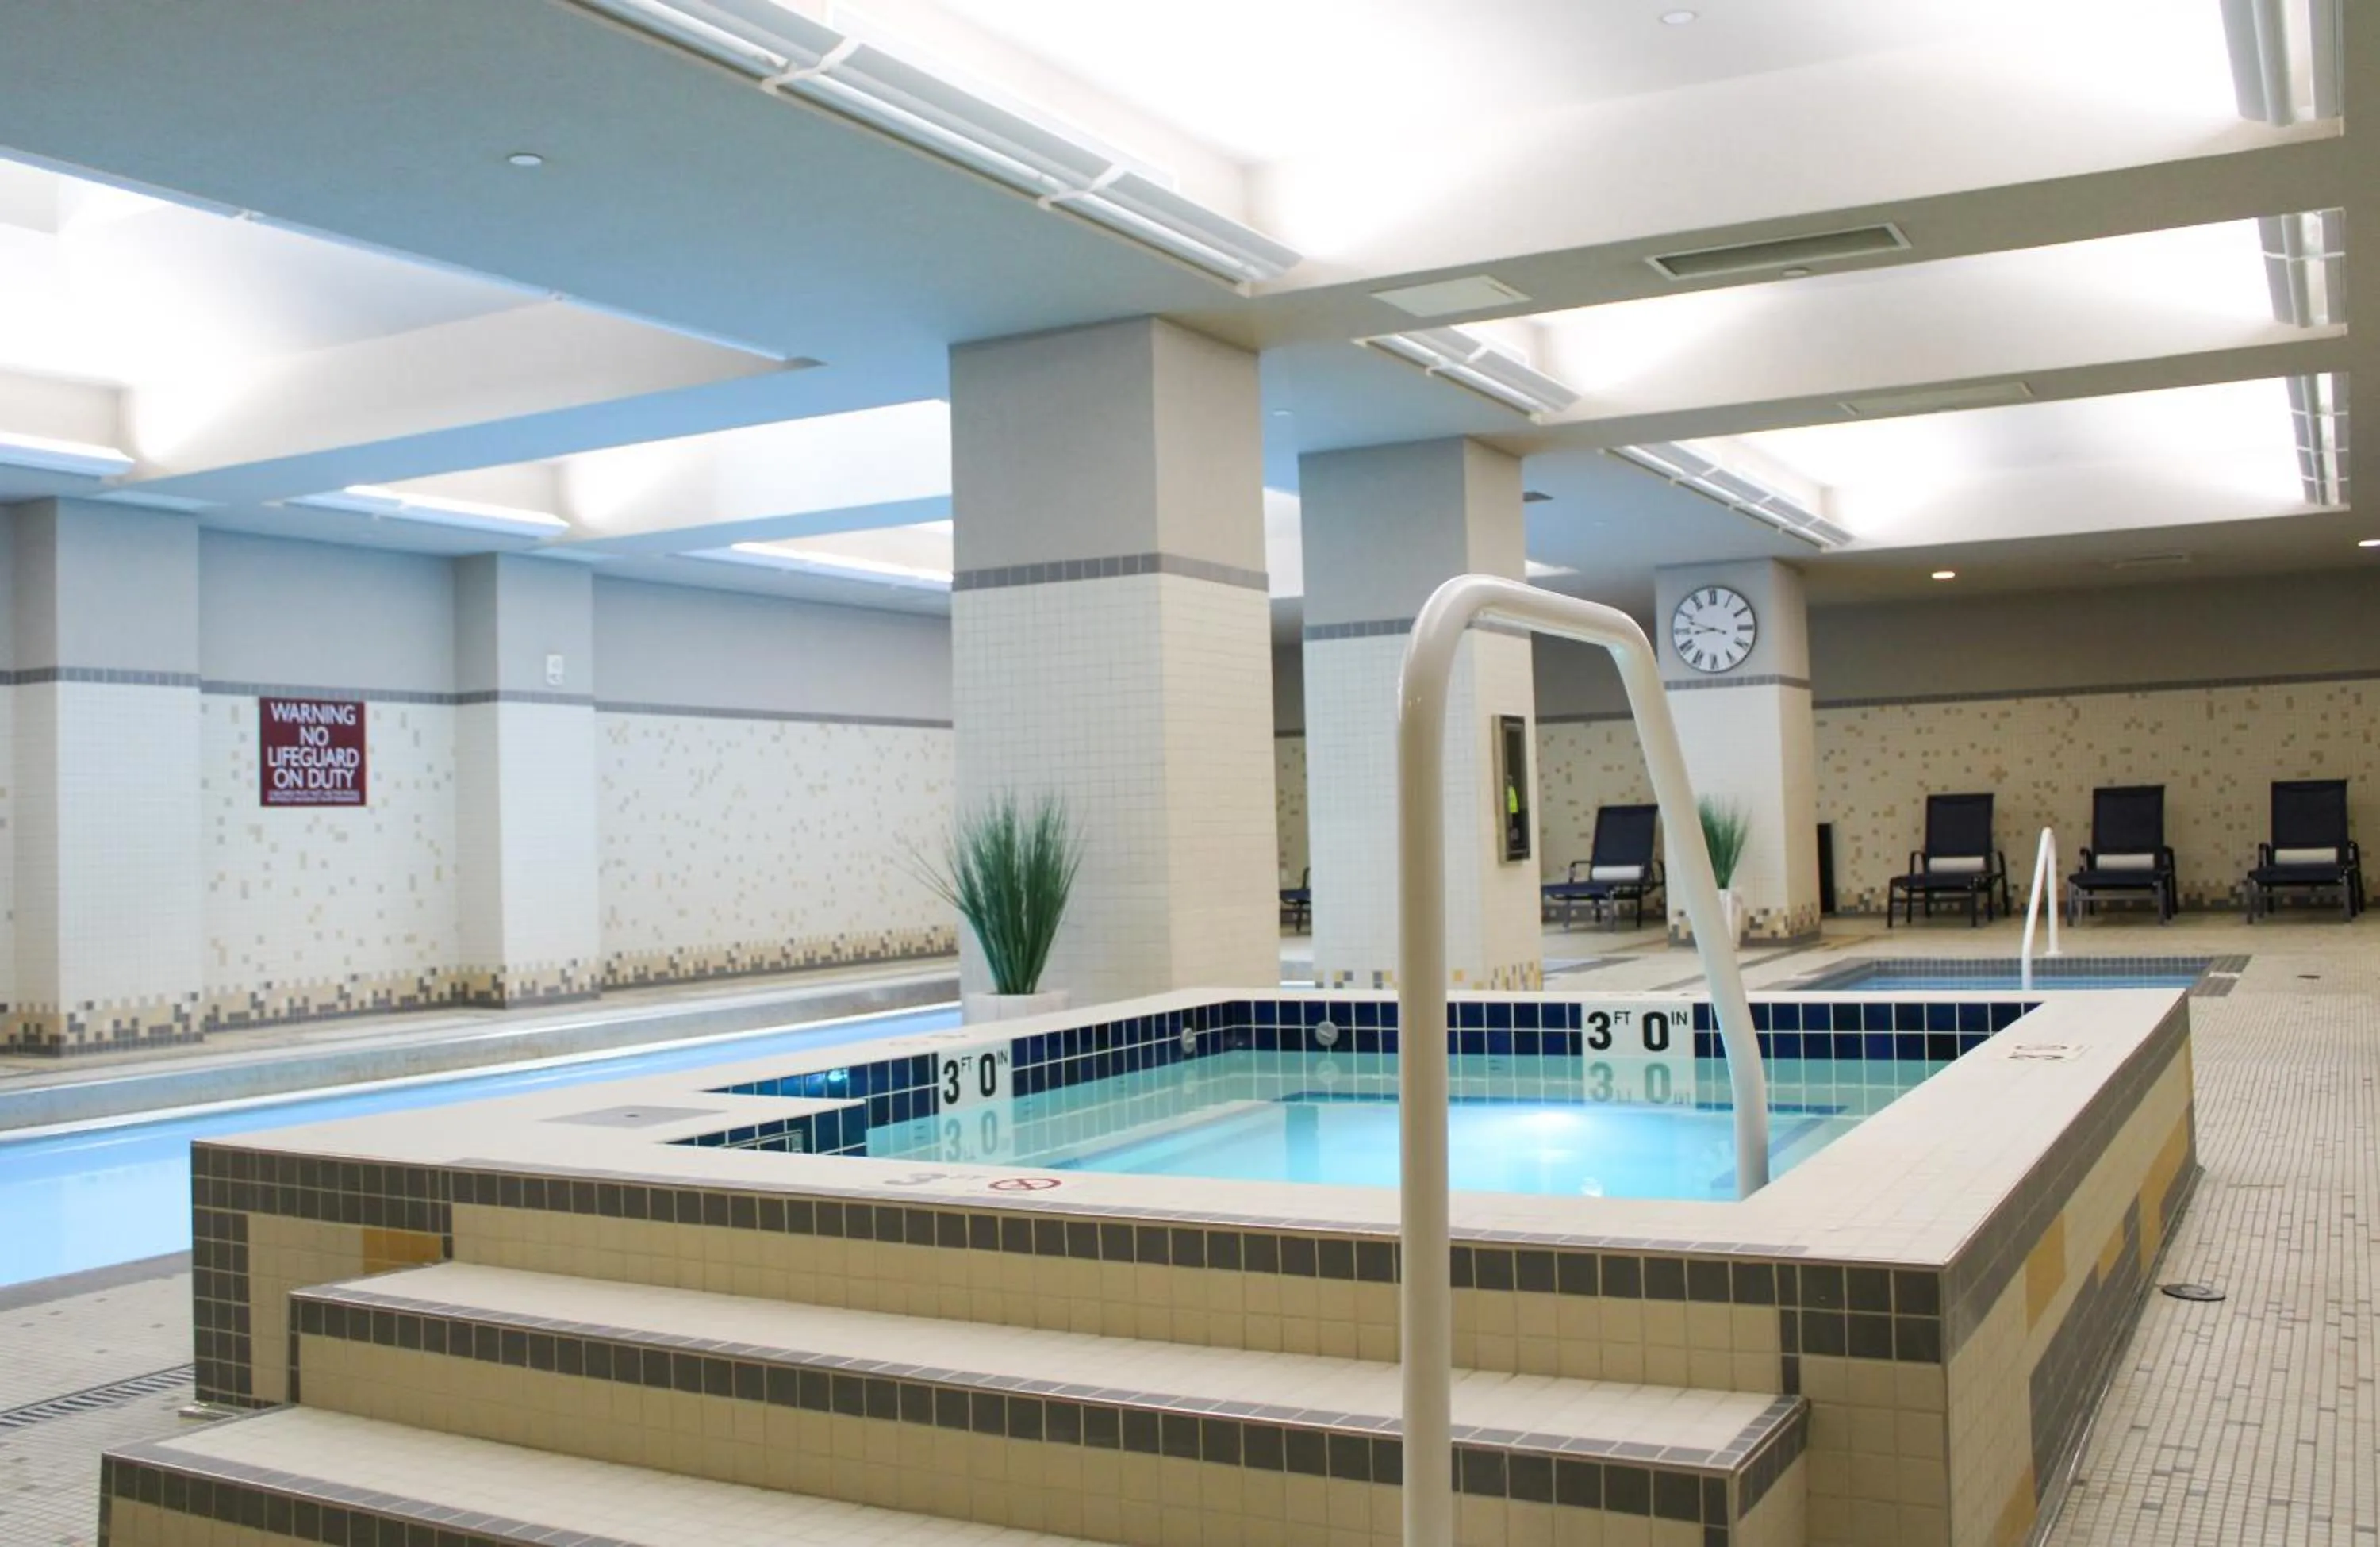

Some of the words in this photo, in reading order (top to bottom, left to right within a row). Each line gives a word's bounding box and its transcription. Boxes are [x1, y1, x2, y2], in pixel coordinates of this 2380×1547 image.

[270, 702, 356, 725] WARNING
[299, 726, 329, 747] NO
[267, 746, 359, 768] LIFEGUARD
[274, 768, 303, 789] ON
[308, 769, 354, 789] DUTY
[1587, 1012, 1612, 1050] 3
[1614, 1011, 1631, 1025] FT
[1642, 1012, 1669, 1051] 0
[1672, 1012, 1687, 1025] IN
[944, 1060, 960, 1104] 3
[961, 1057, 973, 1073] FT
[979, 1053, 996, 1097] 0
[997, 1050, 1008, 1065] IN
